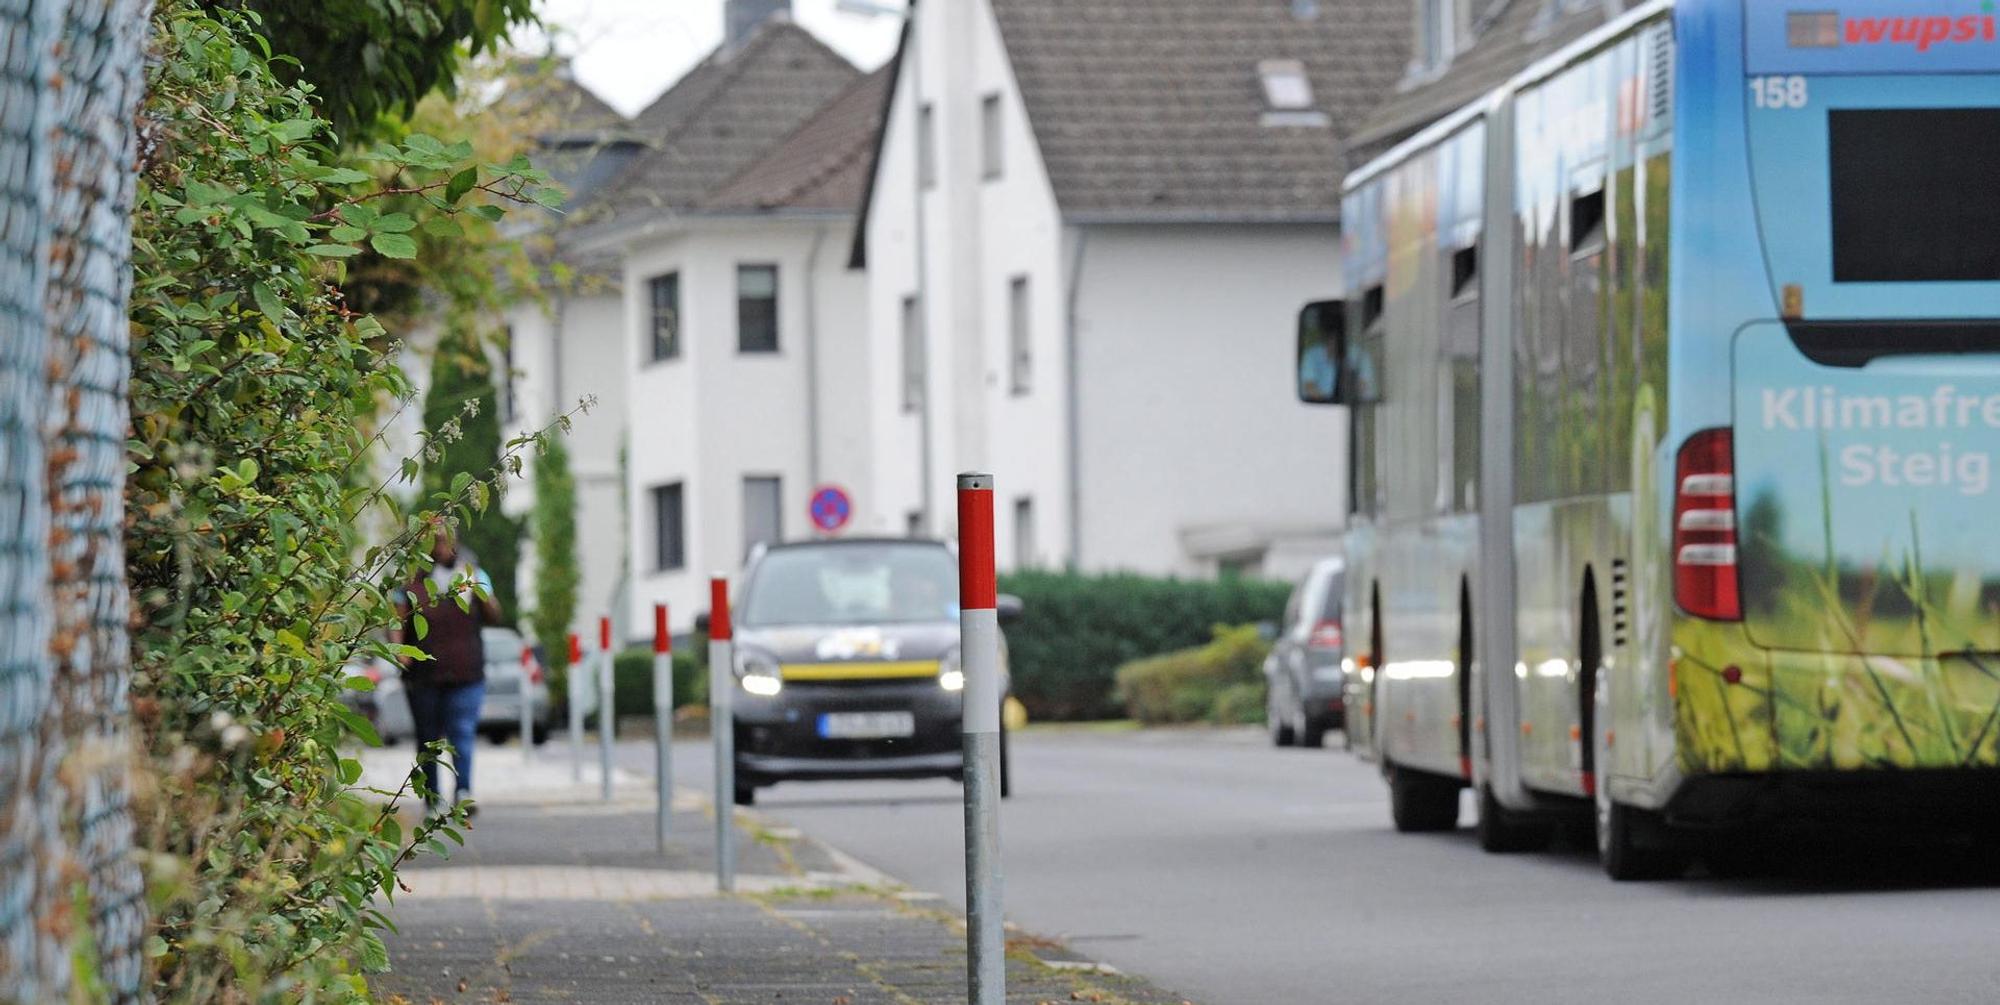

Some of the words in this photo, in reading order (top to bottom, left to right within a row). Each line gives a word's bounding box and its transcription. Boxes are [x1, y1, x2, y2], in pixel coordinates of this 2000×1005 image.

[1844, 1, 1997, 51] wupsi
[1750, 76, 1808, 108] 158
[1841, 442, 1989, 494] Steig
